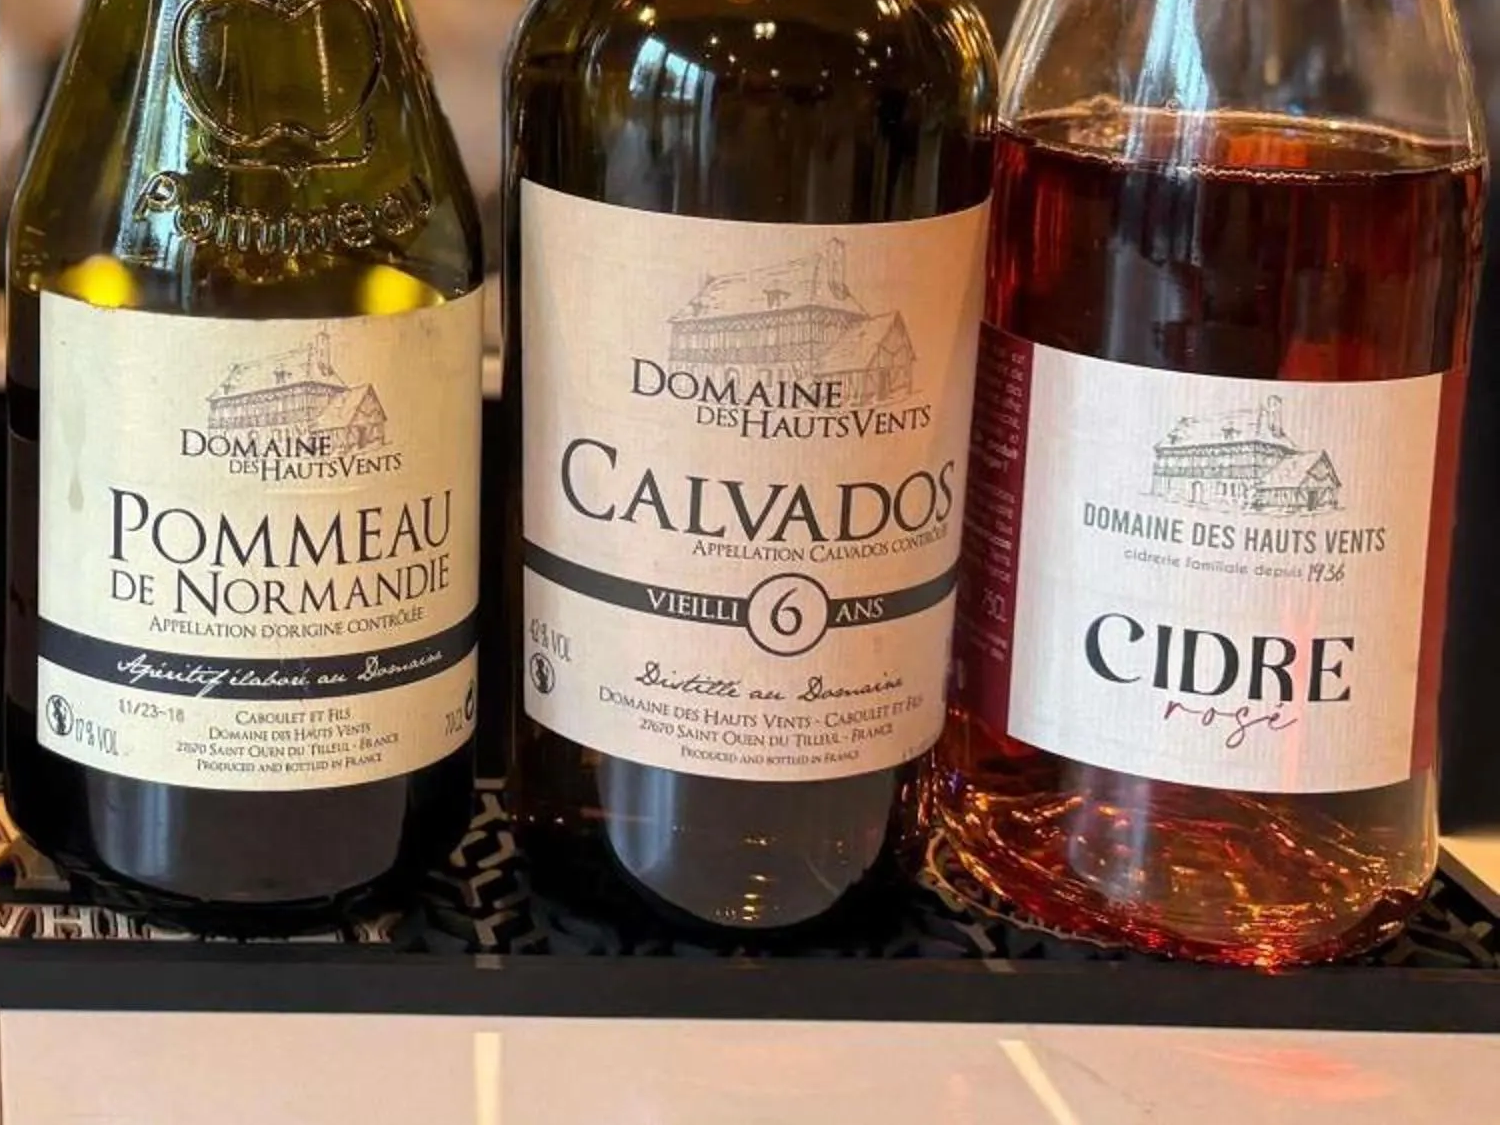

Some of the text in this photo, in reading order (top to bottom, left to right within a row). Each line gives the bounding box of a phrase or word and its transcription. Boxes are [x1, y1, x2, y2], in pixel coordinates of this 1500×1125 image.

[631, 356, 844, 411] DOMAINE
[696, 403, 932, 440] DES HAUTS VENTS
[180, 428, 332, 459] DOMAINE
[228, 451, 403, 483] DES HAUTS VENTS
[560, 436, 956, 544] CALVADOS
[108, 486, 454, 569] POMMEAU
[1082, 501, 1387, 555] DOMAINE DES HAUTS VENTS
[692, 539, 889, 564] APPELLATION CALVADOS
[1123, 547, 1180, 568] cidrerie
[1184, 555, 1250, 575] familiale
[1306, 561, 1346, 584] 1936
[111, 552, 451, 618] DE NORMANDIE
[149, 617, 257, 640] APPELLATION
[261, 618, 344, 640] D'ORIGINE
[646, 585, 885, 637] VIEILLI 6 ANS
[316, 672, 349, 685] au
[357, 649, 444, 684] Domaine
[1083, 611, 1356, 704] CIDRE
[749, 672, 904, 702] au Domaine
[235, 709, 306, 727] CABOULET
[328, 707, 352, 724] FILS
[598, 686, 669, 717] DOMAINE
[673, 706, 699, 722] DES
[703, 706, 758, 727] HAUTS
[763, 714, 812, 730] VENTS
[1163, 701, 1301, 750] rosé
[208, 722, 371, 742] DOMAINE DES HAUTS VENTS
[677, 723, 719, 745] SAINT
[722, 730, 766, 747] OUEN
[769, 732, 789, 747] DU
[851, 723, 894, 744] FRANCE
[209, 743, 245, 758] SAINT
[248, 745, 285, 759] OUEN
[287, 745, 306, 758] DU
[257, 761, 283, 773] AND
[739, 752, 764, 764] AND
